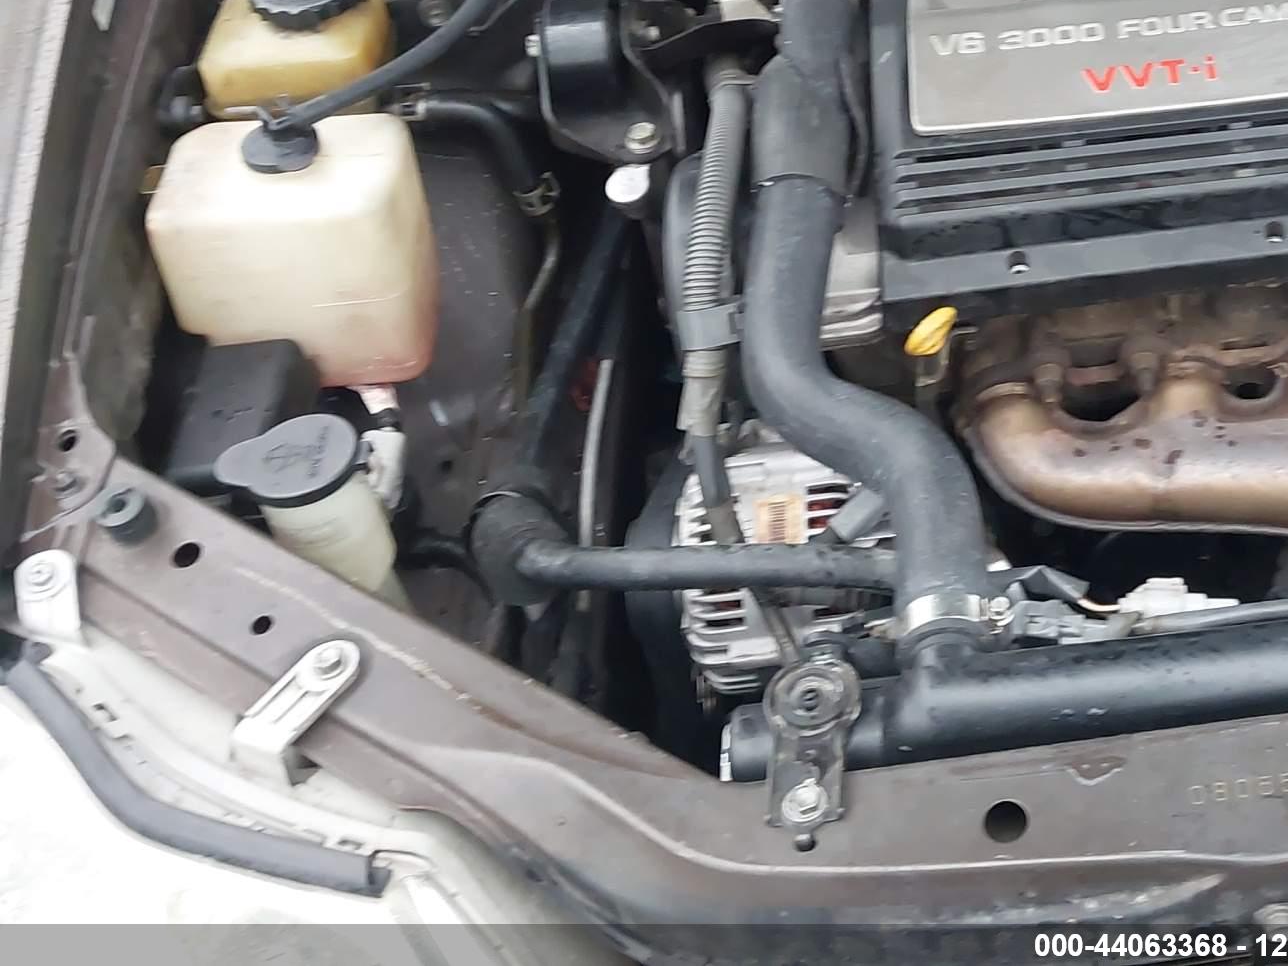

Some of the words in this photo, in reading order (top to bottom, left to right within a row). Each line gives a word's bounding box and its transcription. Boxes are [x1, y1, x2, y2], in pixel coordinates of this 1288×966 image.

[928, 33, 984, 56] V6
[998, 23, 1105, 51] 3000
[1117, 11, 1215, 40] FOUR
